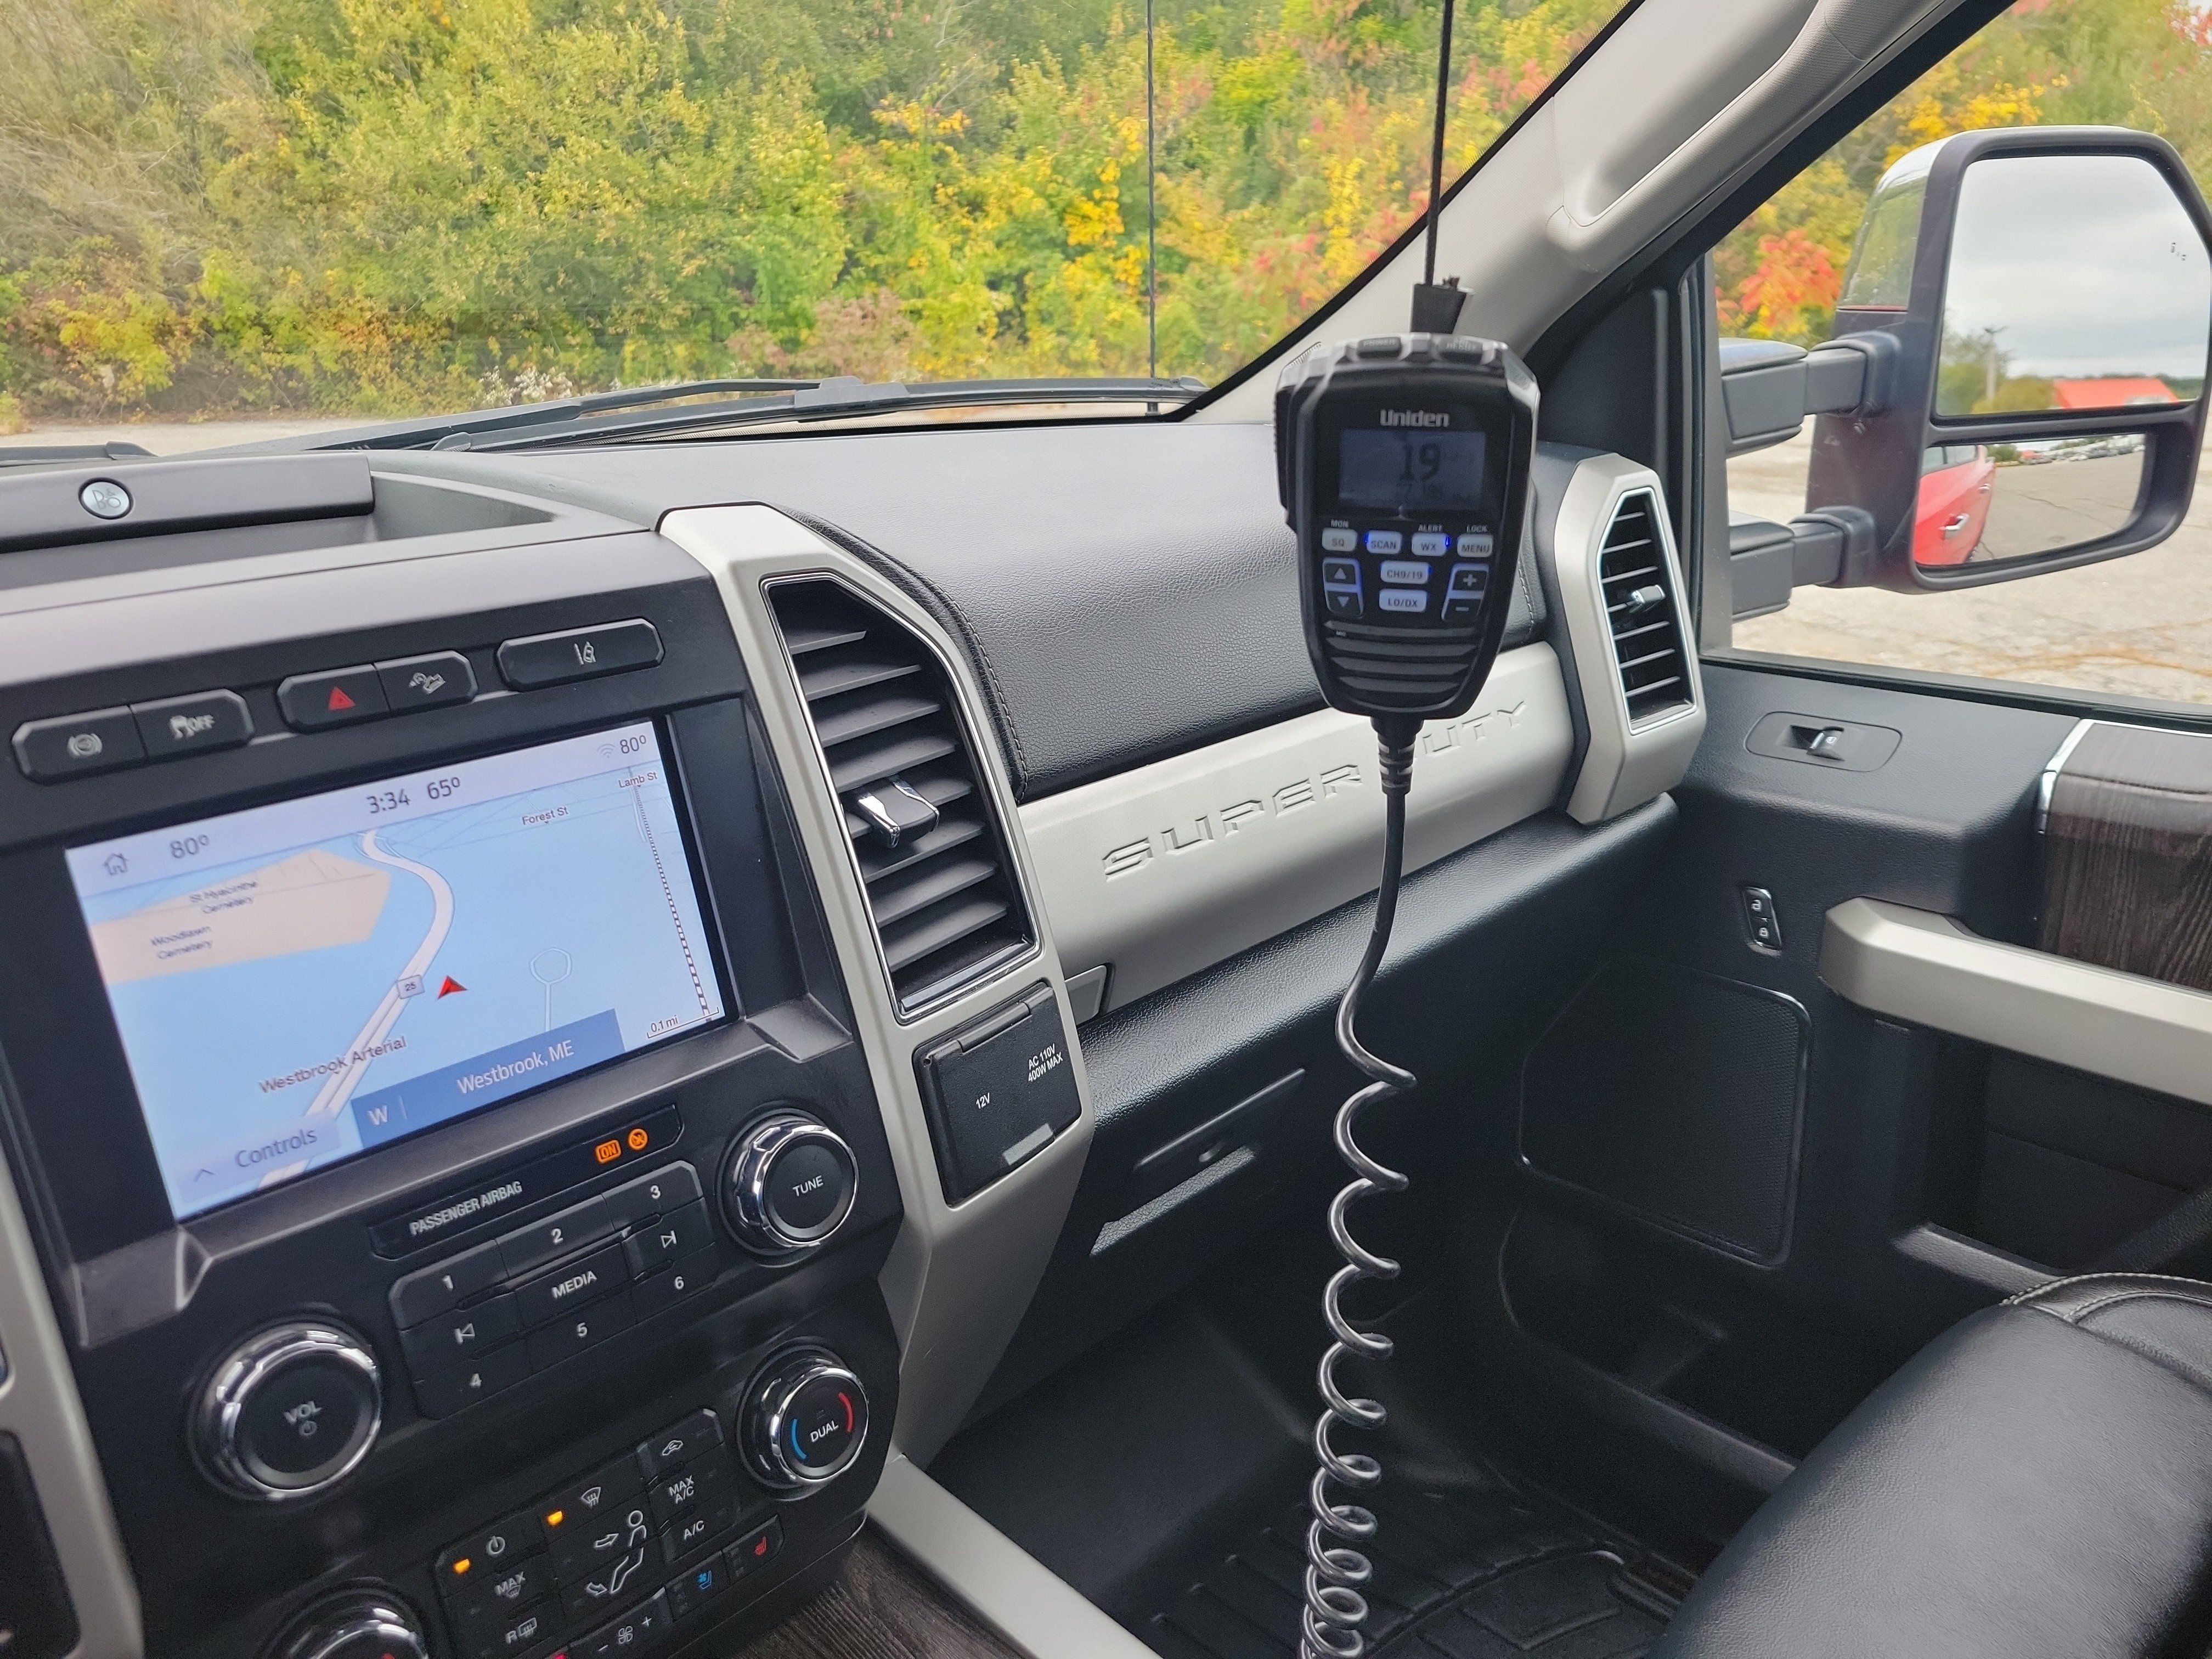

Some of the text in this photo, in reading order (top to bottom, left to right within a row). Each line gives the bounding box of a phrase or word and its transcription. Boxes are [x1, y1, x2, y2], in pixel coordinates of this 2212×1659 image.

[1380, 409, 1449, 427] Uniden
[1400, 443, 1441, 481] 19
[1331, 520, 1348, 528] MON
[1418, 524, 1443, 532] ALERT
[1466, 524, 1487, 533] LOCK
[1331, 538, 1345, 548] SQ
[1370, 539, 1397, 550] SCAN
[1421, 543, 1437, 552] WX
[1462, 543, 1490, 553] MENU
[1386, 569, 1423, 580] CH9/19
[1387, 597, 1418, 608] LO/DX
[618, 771, 658, 788] Lamb St
[367, 776, 461, 815] 3:34 65°
[1102, 701, 1527, 881] SUPER UTY
[521, 805, 569, 826] Forest St
[650, 1014, 679, 1033] 0.1 mi
[258, 1035, 407, 1094] Westbrook Arterial
[1028, 1043, 1056, 1070] AC 110V
[1028, 1051, 1063, 1082] 400W MAX
[367, 1039, 575, 1126] W Westbrook, ME
[975, 1092, 991, 1109] 12V
[234, 1127, 318, 1169] Controls
[650, 1186, 661, 1199] 3
[792, 1175, 824, 1197] TUNE
[410, 1198, 481, 1236] PASSENGER
[479, 1180, 522, 1210] AIRBAG
[551, 1228, 563, 1244] 2
[442, 1275, 454, 1290] 1
[552, 1271, 597, 1300] MEDIA
[674, 1276, 685, 1290] 6
[575, 1322, 589, 1338] 5
[469, 1373, 482, 1389] 4
[282, 1400, 323, 1425] VOL
[810, 1420, 839, 1443] DUAL
[669, 1475, 694, 1497] MAX
[675, 1486, 694, 1504] A/C
[684, 1520, 705, 1541] A/C
[495, 1571, 526, 1595] MAX
[506, 1630, 518, 1644] R
